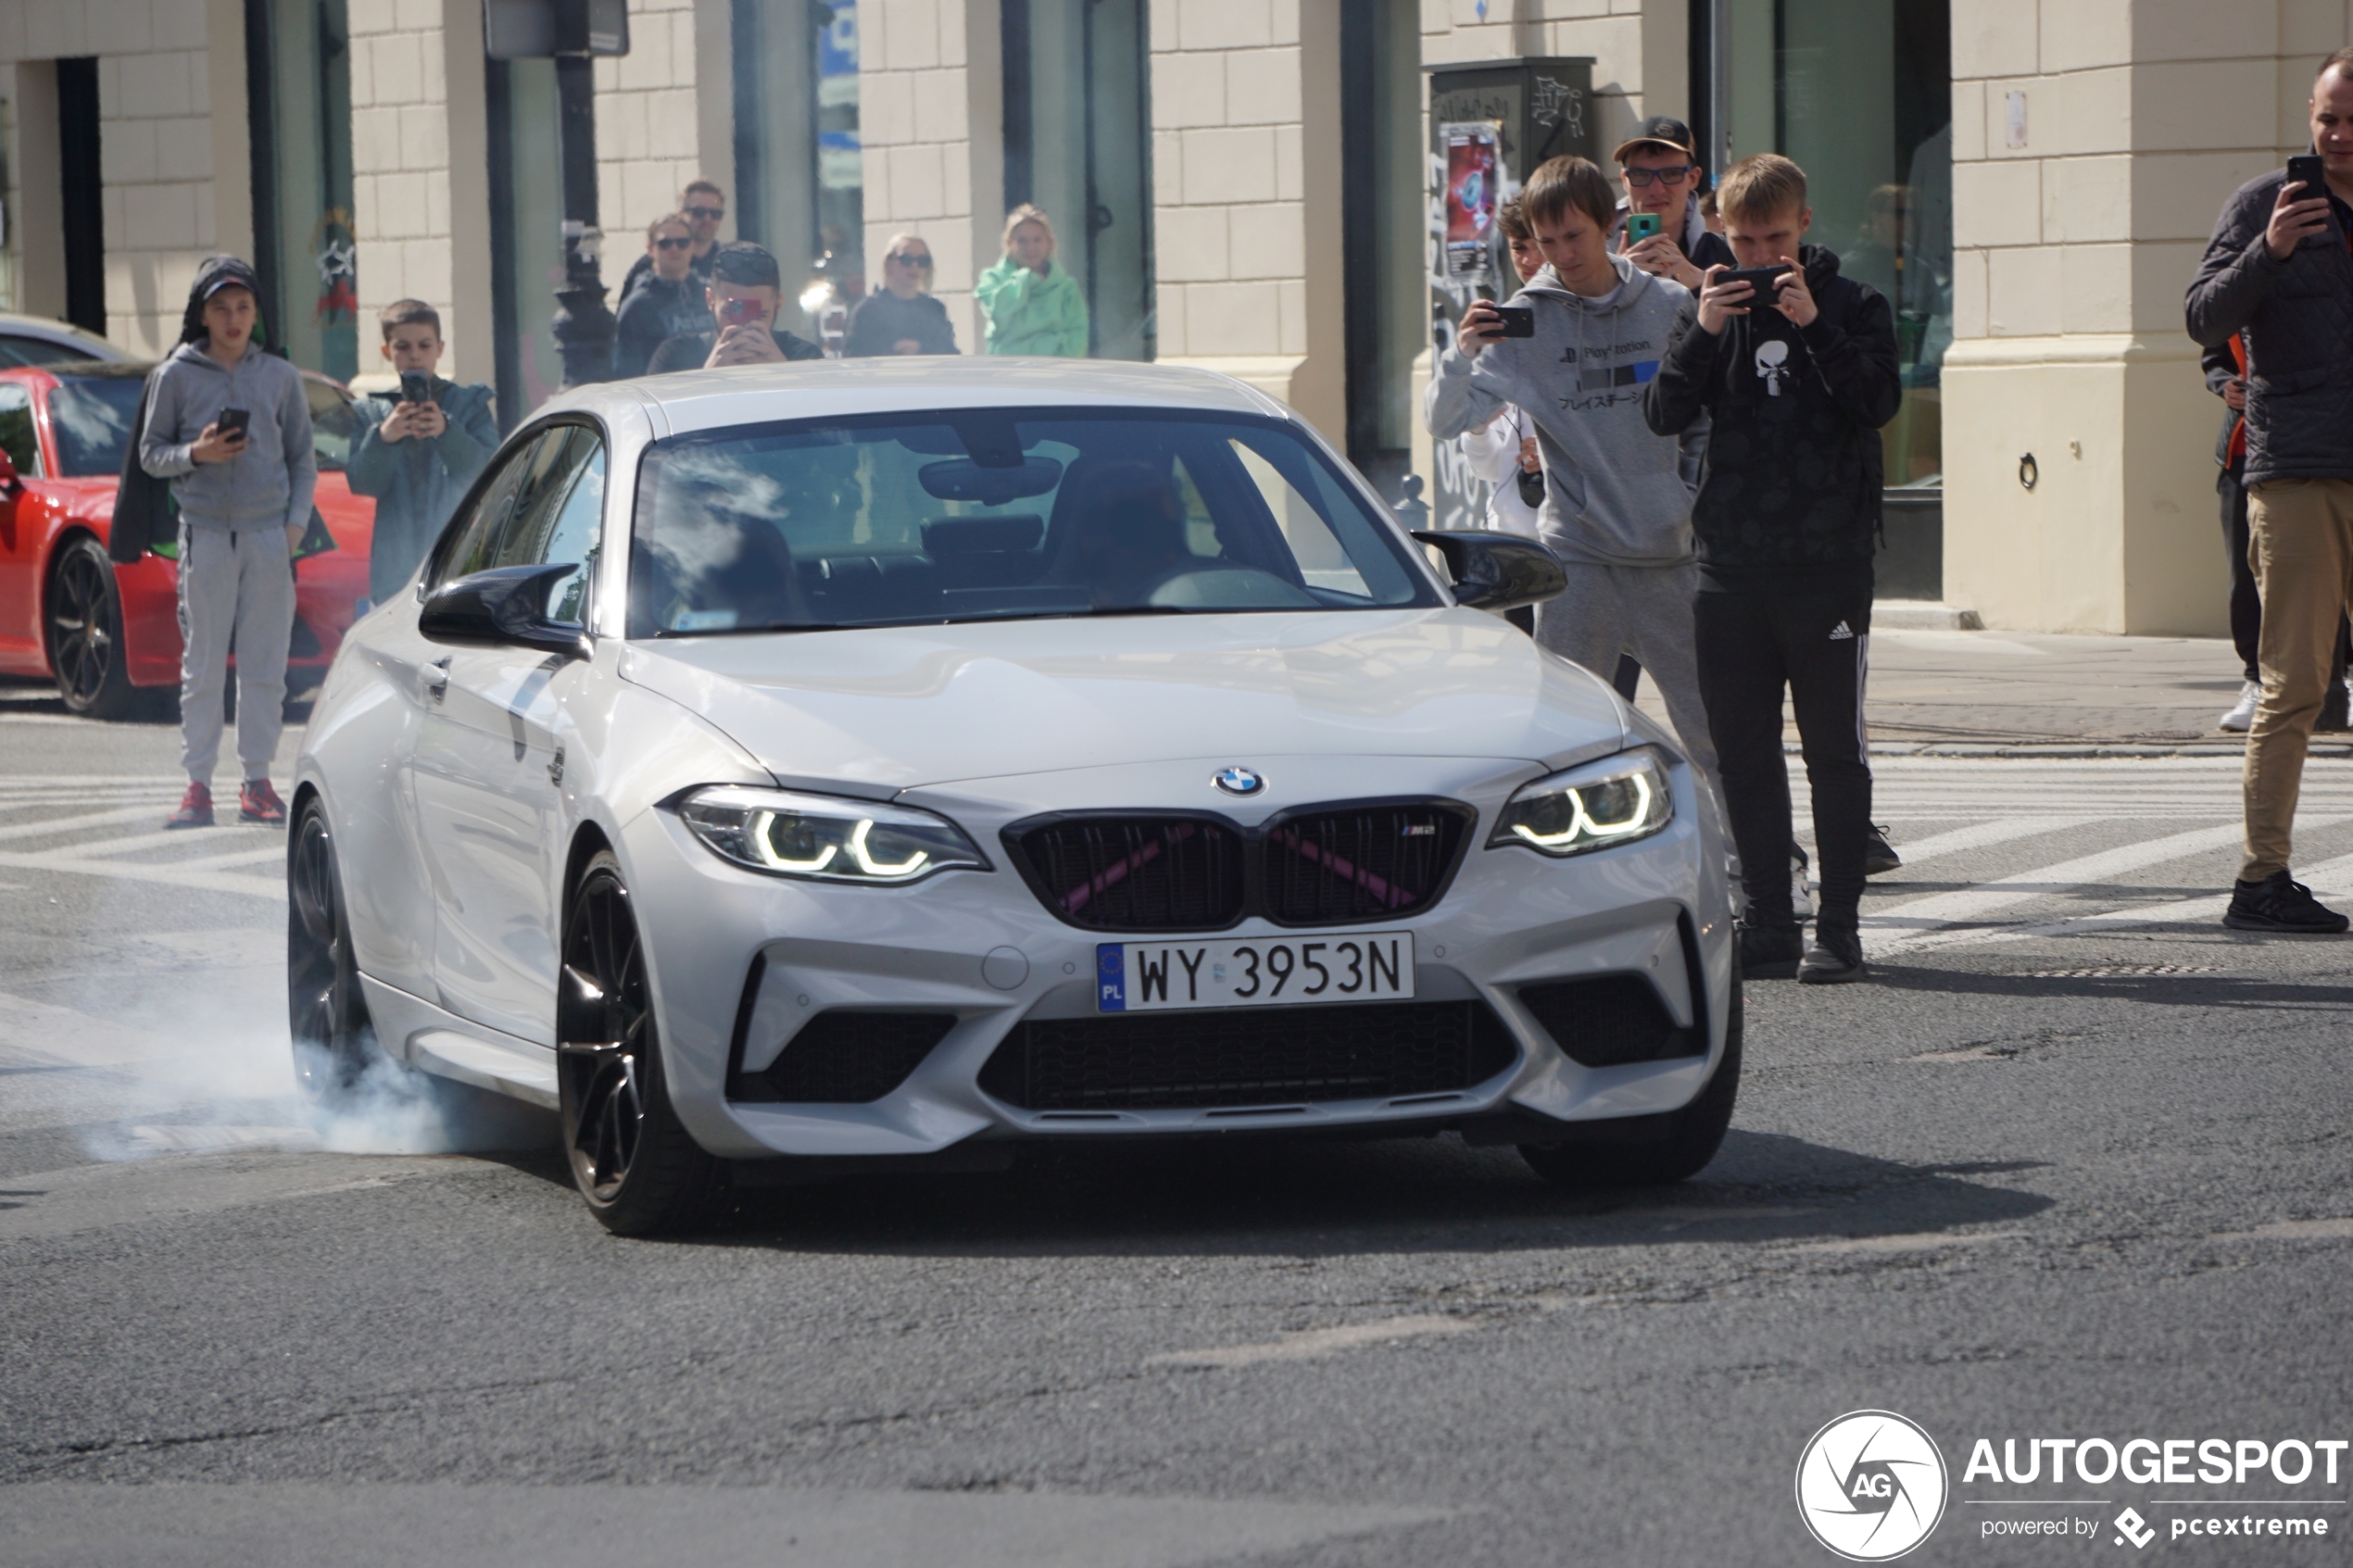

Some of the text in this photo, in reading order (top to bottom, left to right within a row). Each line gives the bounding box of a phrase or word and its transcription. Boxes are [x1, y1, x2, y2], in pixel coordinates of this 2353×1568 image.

[1410, 825, 1435, 835] M2
[1138, 939, 1401, 1002] WY 3953N
[1102, 985, 1123, 1000] PL
